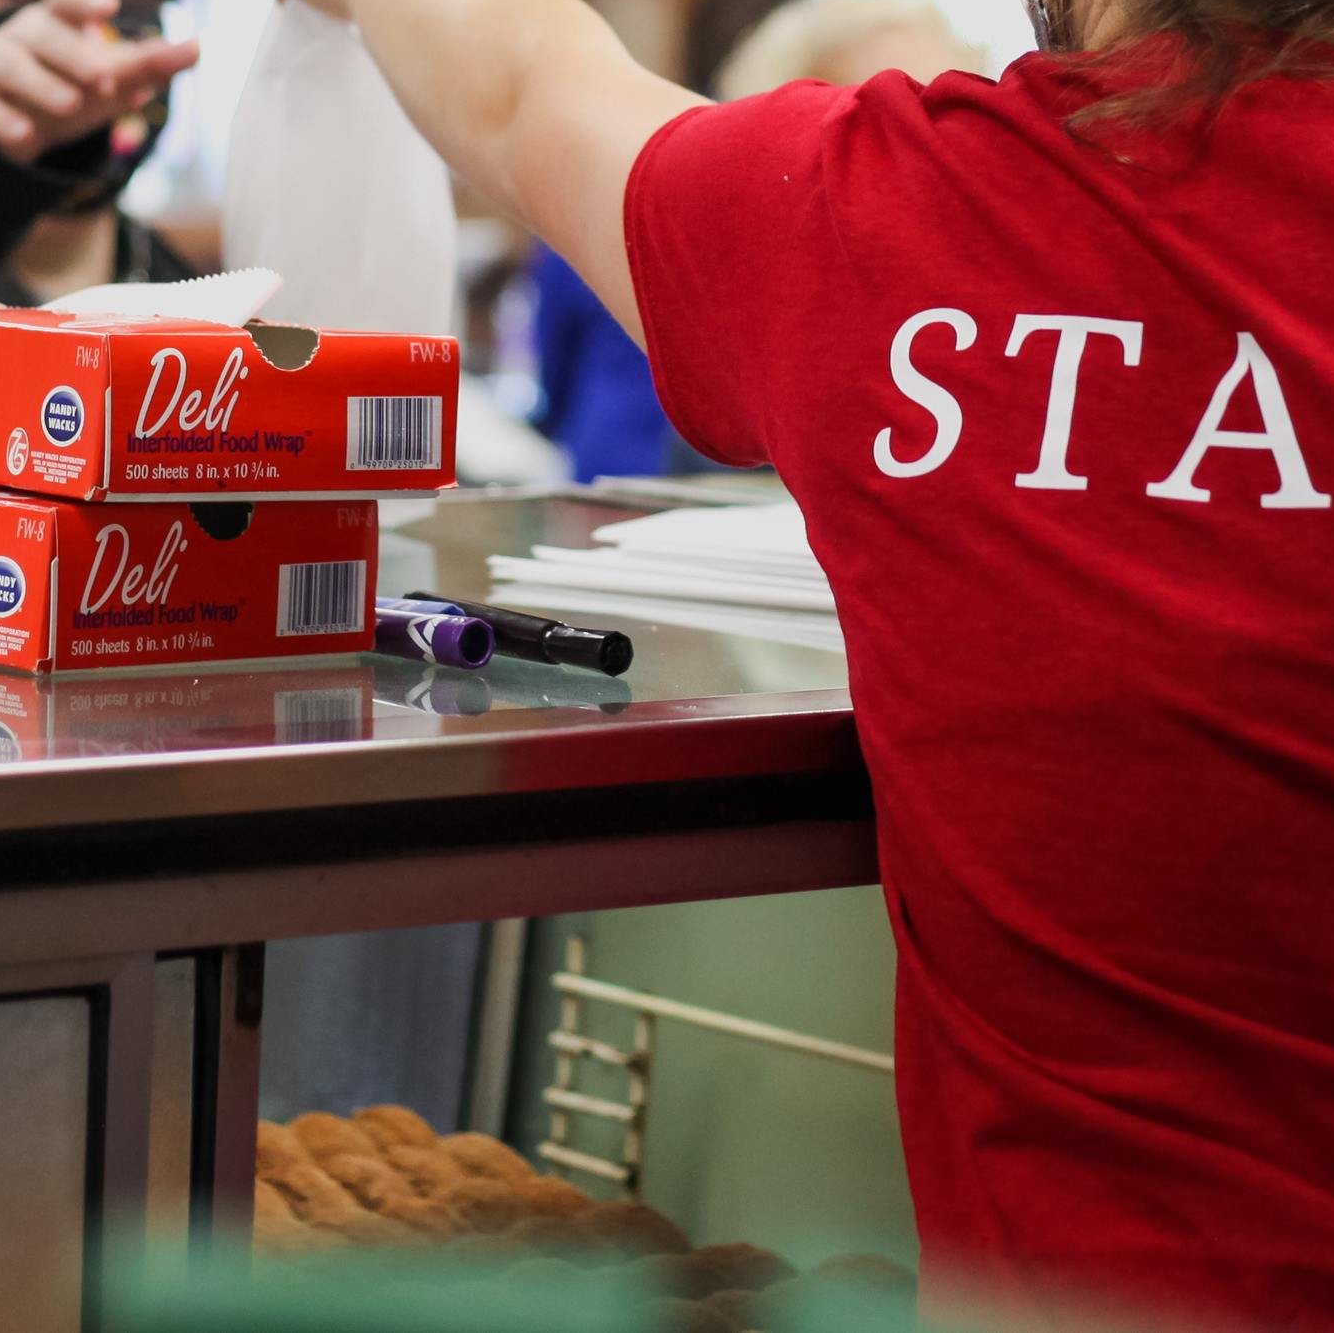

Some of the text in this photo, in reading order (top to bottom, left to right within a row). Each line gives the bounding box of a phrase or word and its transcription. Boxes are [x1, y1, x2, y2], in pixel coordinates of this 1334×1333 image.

[76, 346, 100, 369] FW-8
[410, 341, 451, 363] FW-8
[135, 347, 248, 439] Deli
[50, 403, 77, 417] HANDY
[48, 418, 75, 432] WACKS
[127, 430, 304, 456] Interfolded Food Wrap
[125, 464, 149, 480] 500
[152, 463, 189, 479] sheets
[196, 463, 203, 479] 8
[207, 463, 220, 479] in.
[223, 467, 230, 478] x
[234, 463, 248, 478] 10
[267, 463, 280, 478] in.
[17, 517, 45, 541] FW-8
[80, 520, 187, 615] Deli
[73, 601, 237, 629] Interfolded Food Wrap
[71, 639, 92, 656] 500
[96, 638, 130, 654] sheets
[136, 636, 143, 652] 8
[147, 636, 158, 651] in.
[162, 639, 168, 651] x
[172, 634, 185, 649] 10
[202, 634, 214, 649] in.
